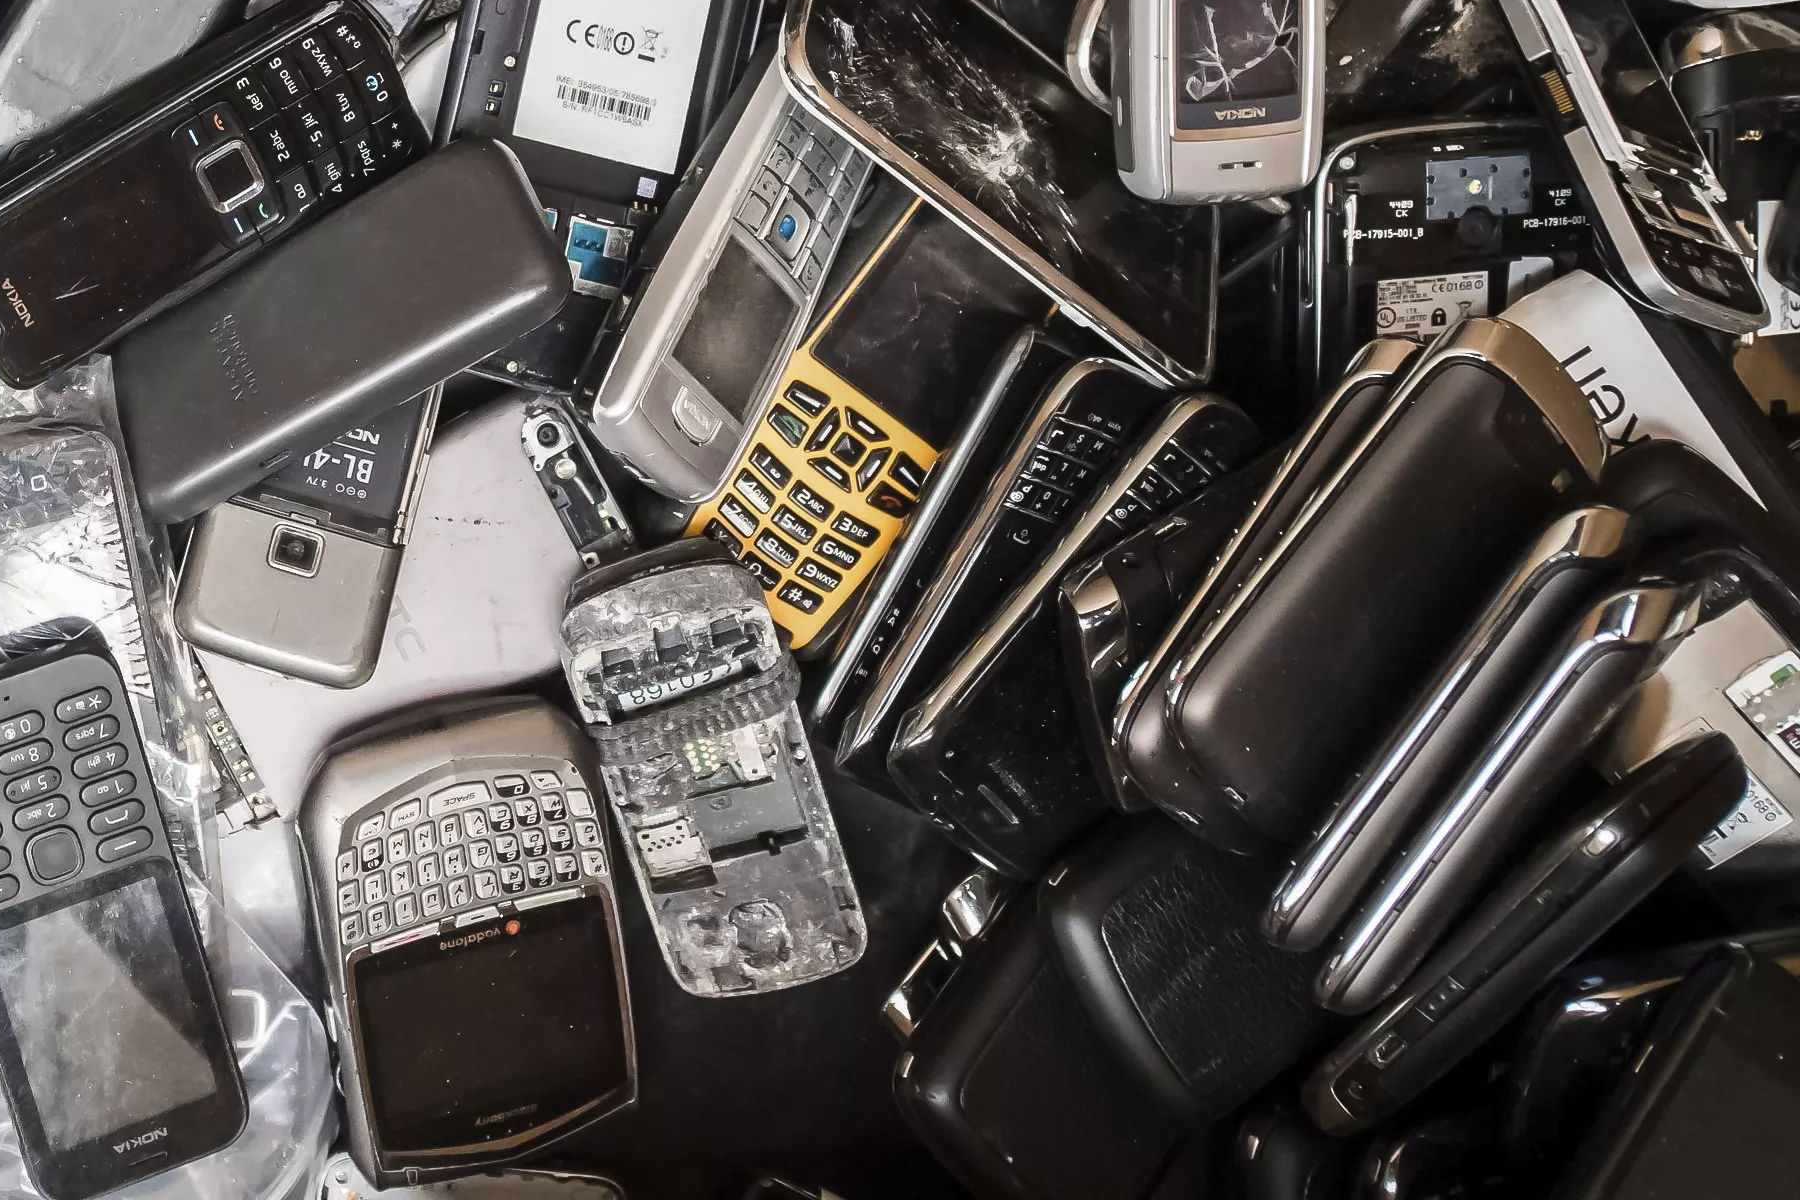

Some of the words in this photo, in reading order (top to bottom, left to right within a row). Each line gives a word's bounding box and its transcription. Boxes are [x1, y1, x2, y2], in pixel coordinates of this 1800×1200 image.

[302, 38, 315, 50] 9
[269, 57, 281, 69] 6
[236, 77, 250, 89] 3
[343, 111, 356, 122] 8
[1214, 107, 1266, 121] NOKIA
[310, 131, 322, 143] 5
[277, 150, 290, 162] 2
[363, 167, 376, 176] 7
[331, 184, 343, 193] 4
[1396, 209, 1408, 217] CK
[2, 278, 34, 328] NOKIA
[797, 489, 811, 501] 2
[839, 519, 853, 532] 3
[822, 540, 837, 553] 6
[803, 563, 818, 577] 9
[439, 927, 501, 950] vodafone
[112, 1127, 168, 1155] NOKIA
